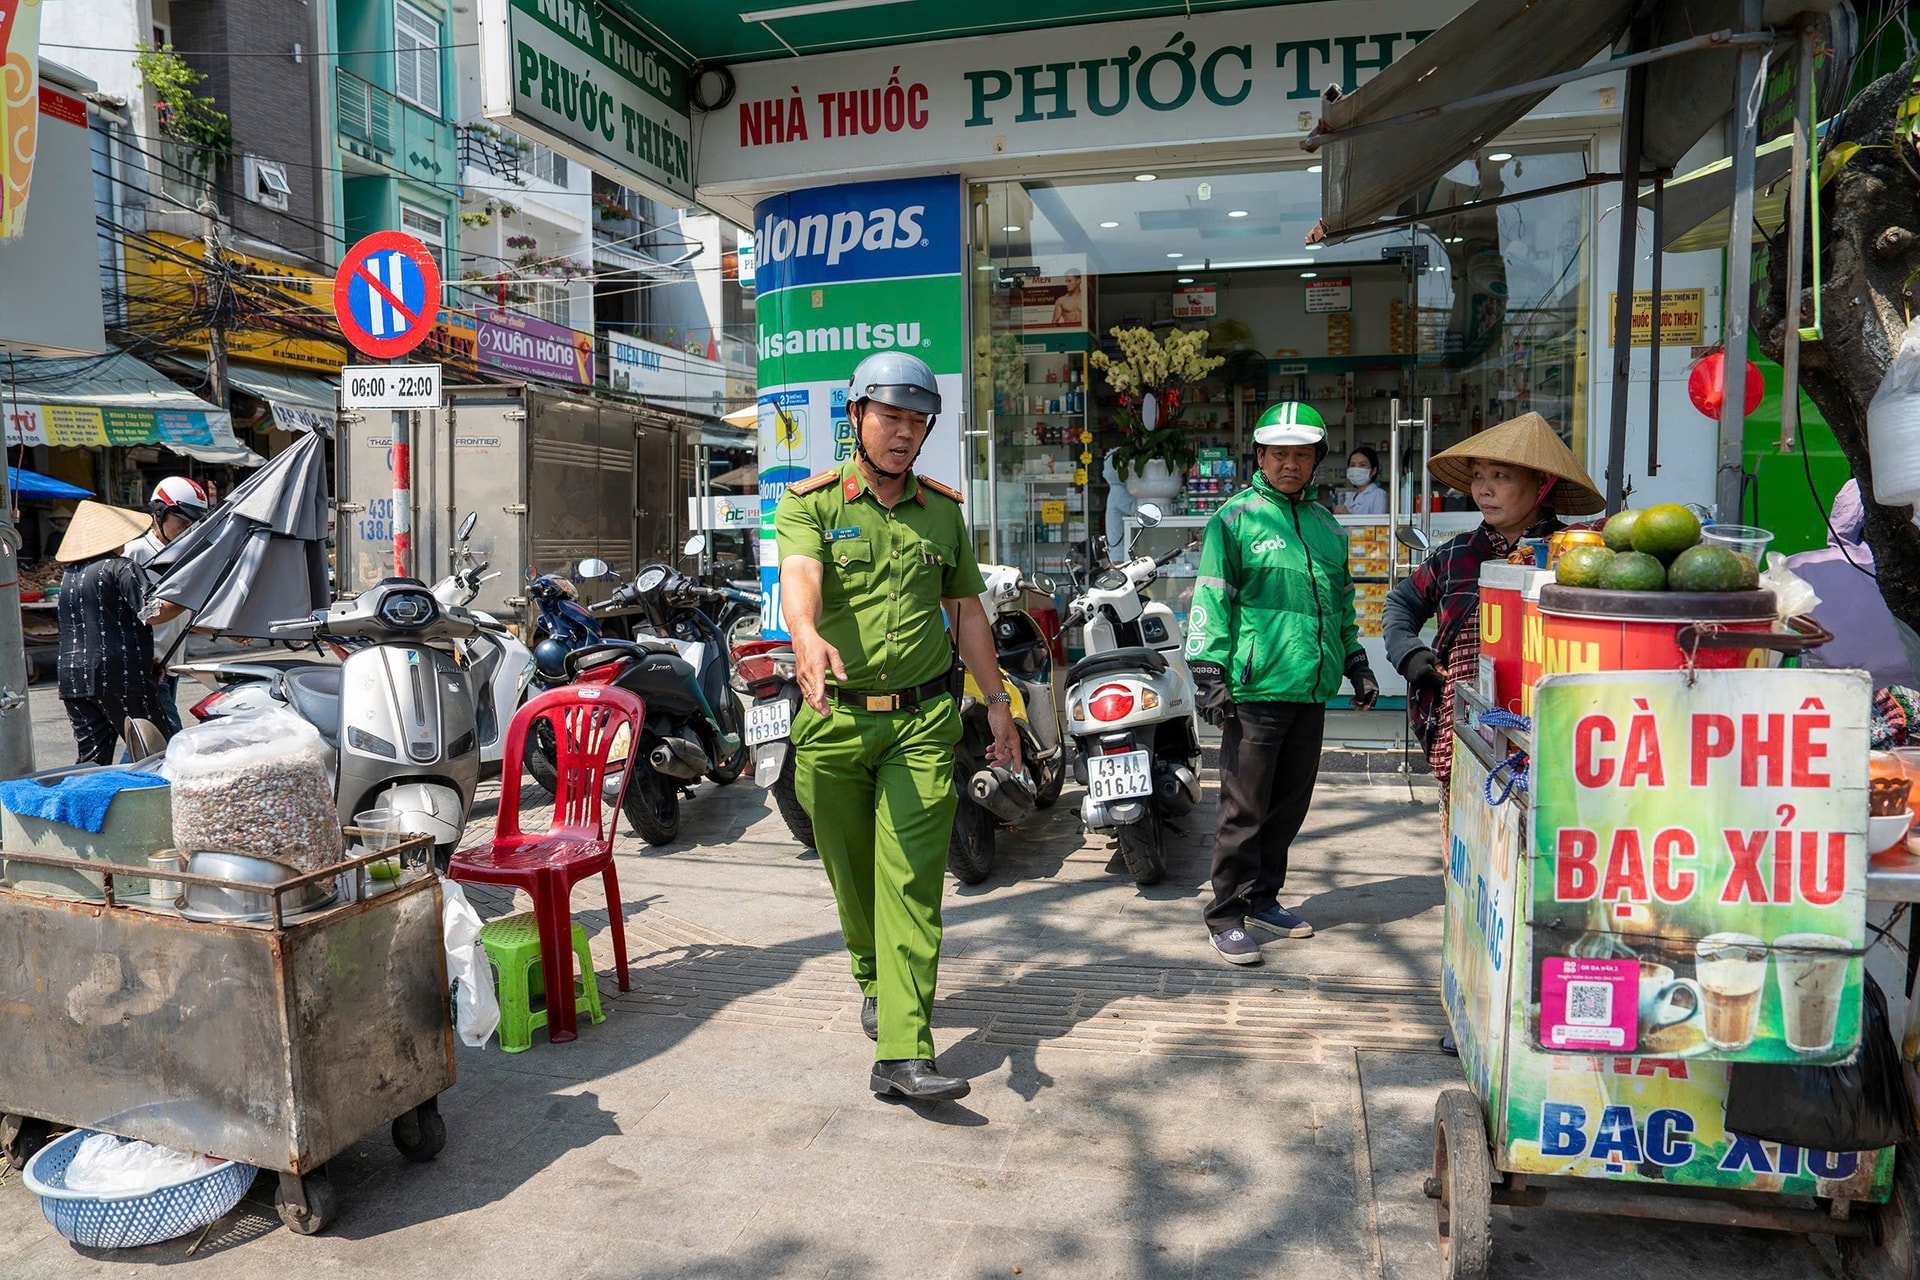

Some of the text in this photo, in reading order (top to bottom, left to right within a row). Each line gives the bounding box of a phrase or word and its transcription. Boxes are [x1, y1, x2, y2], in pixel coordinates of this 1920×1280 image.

[600, 22, 673, 97] THUỐC
[739, 85, 809, 147] NHÀ
[818, 65, 929, 138] THUỐC
[963, 32, 1253, 127] PHƯỚC
[517, 39, 689, 186] PHƯỚC THIỆN
[491, 328, 533, 358] XUÂN
[351, 378, 385, 397] 06:00
[398, 377, 433, 397] 22:00
[455, 438, 499, 446] FRONTIER
[1250, 534, 1287, 554] Grab
[752, 704, 782, 725] 81-D1
[749, 719, 788, 742] 163.85
[1574, 696, 1832, 790] CÀ PHÊ
[1098, 755, 1140, 778] 43-AA
[1094, 774, 1149, 798] 816.42
[1554, 827, 1696, 917] BẠC
[1720, 804, 1847, 906] XỈU
[1540, 1102, 1694, 1174] BẠC
